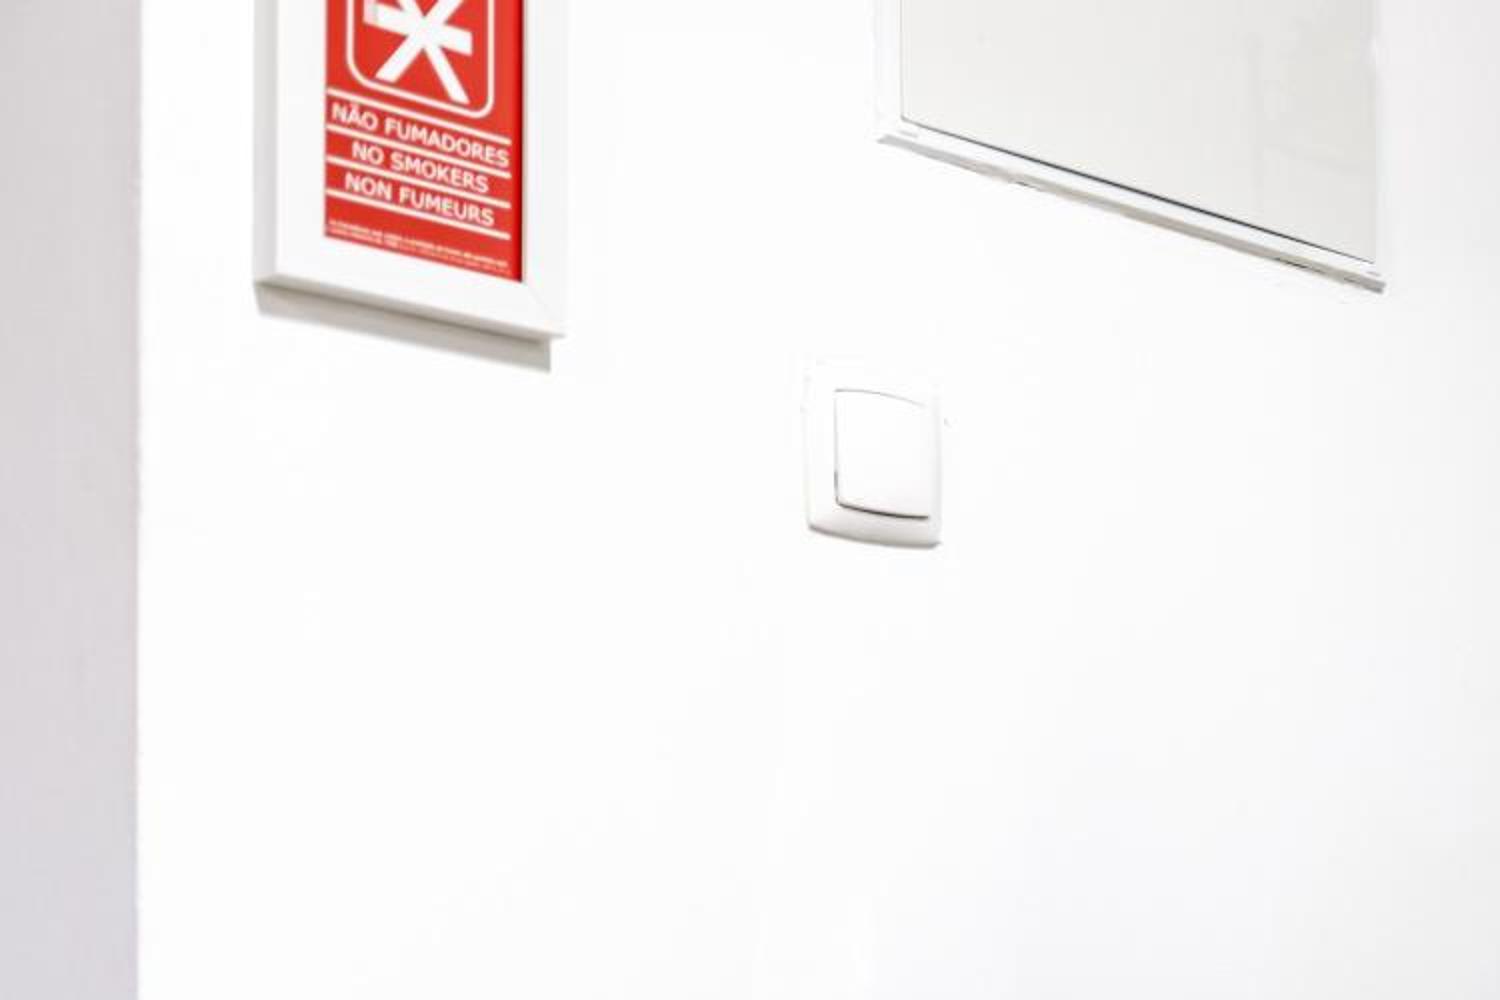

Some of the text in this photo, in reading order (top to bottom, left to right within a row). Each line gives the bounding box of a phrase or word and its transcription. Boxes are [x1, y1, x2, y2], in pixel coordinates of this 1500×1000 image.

[331, 102, 511, 168] NÃO FUMADORES
[351, 141, 490, 193] NO SMOKERS
[344, 173, 495, 226] NON FUMEURS
